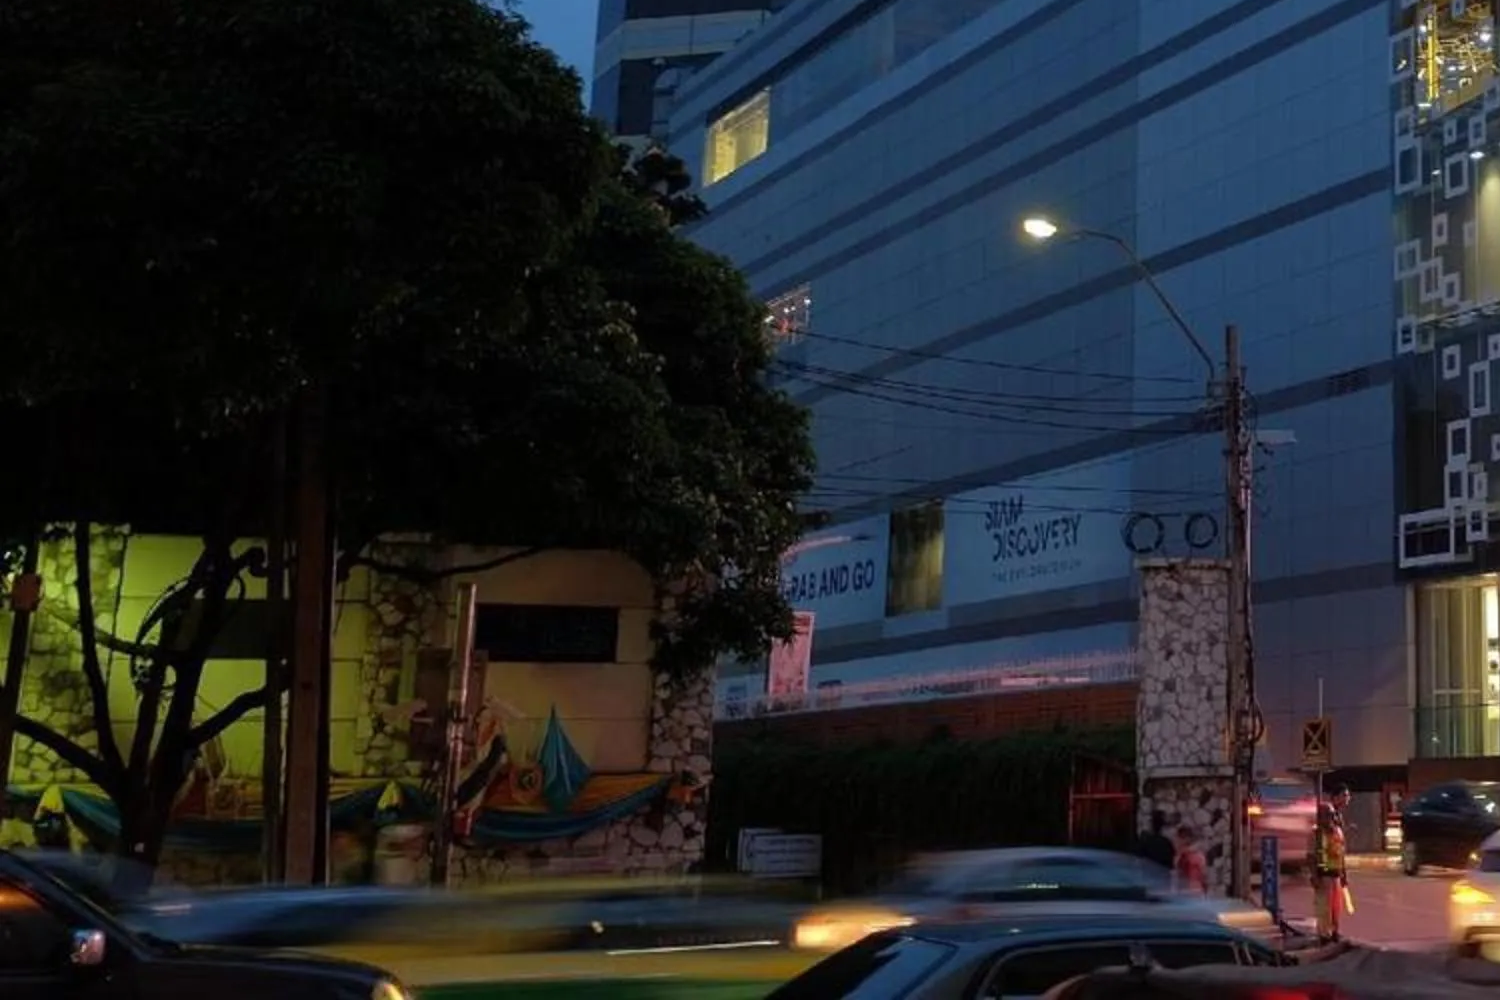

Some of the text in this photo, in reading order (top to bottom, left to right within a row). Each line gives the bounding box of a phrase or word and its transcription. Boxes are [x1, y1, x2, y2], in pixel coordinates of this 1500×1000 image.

[993, 513, 1082, 562] DISCOVERY
[819, 564, 850, 599] AND
[853, 558, 876, 592] GO
